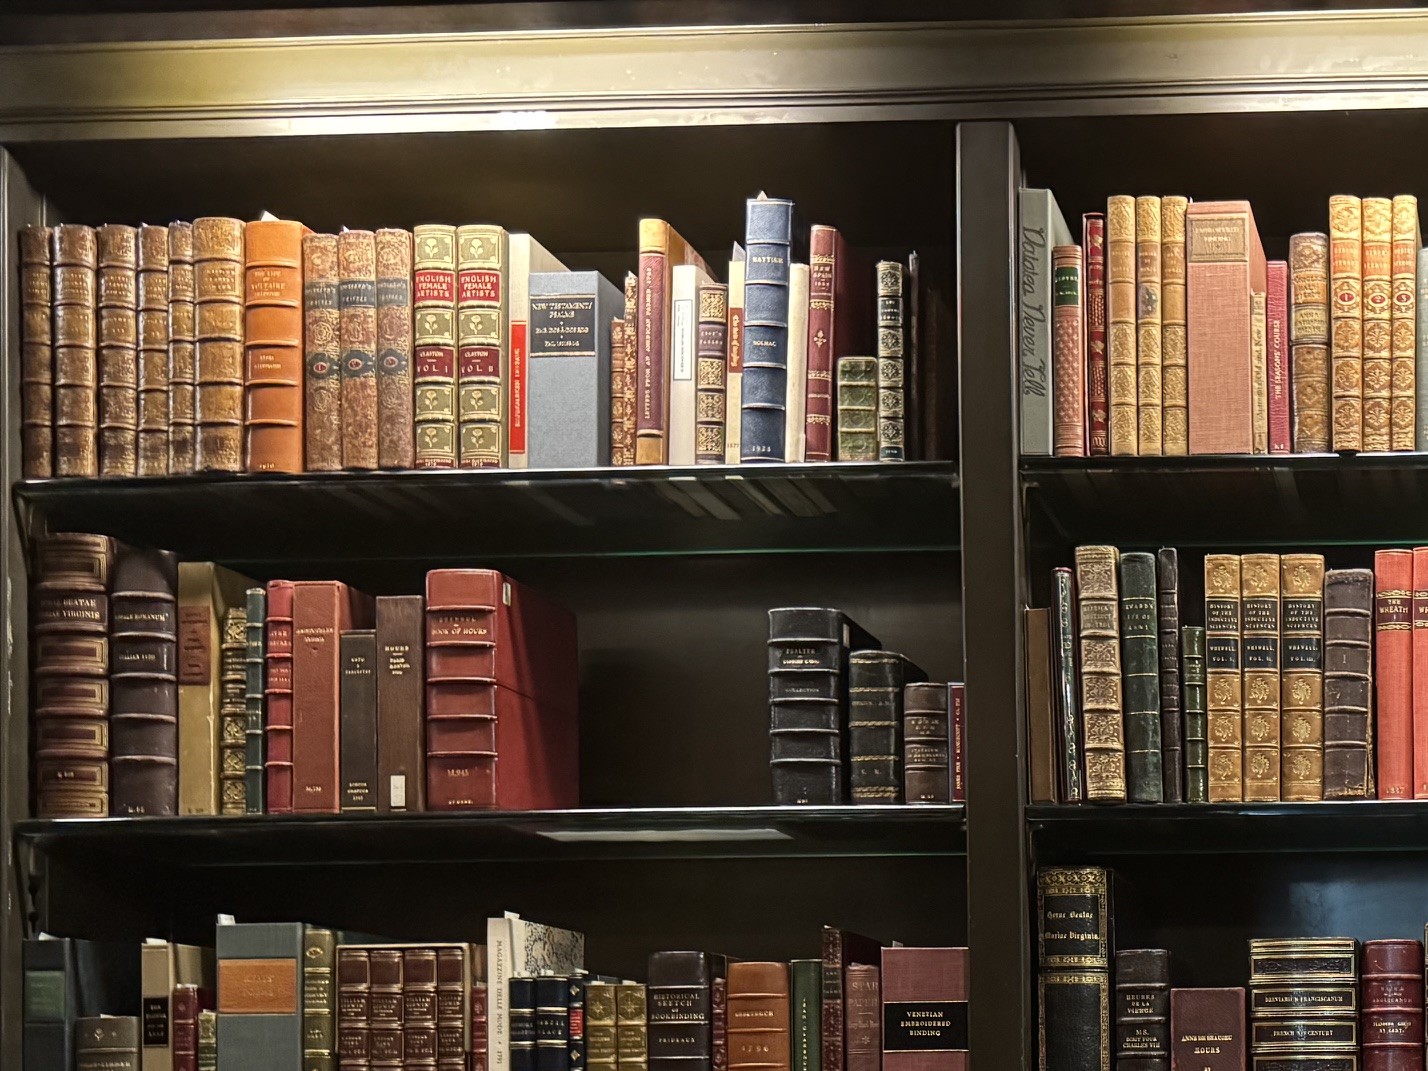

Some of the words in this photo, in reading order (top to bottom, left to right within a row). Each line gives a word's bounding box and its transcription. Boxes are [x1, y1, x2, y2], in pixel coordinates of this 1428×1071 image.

[464, 282, 492, 290] FEMALE
[462, 290, 496, 298] ARTISTS
[909, 1029, 941, 1037] BINDING
